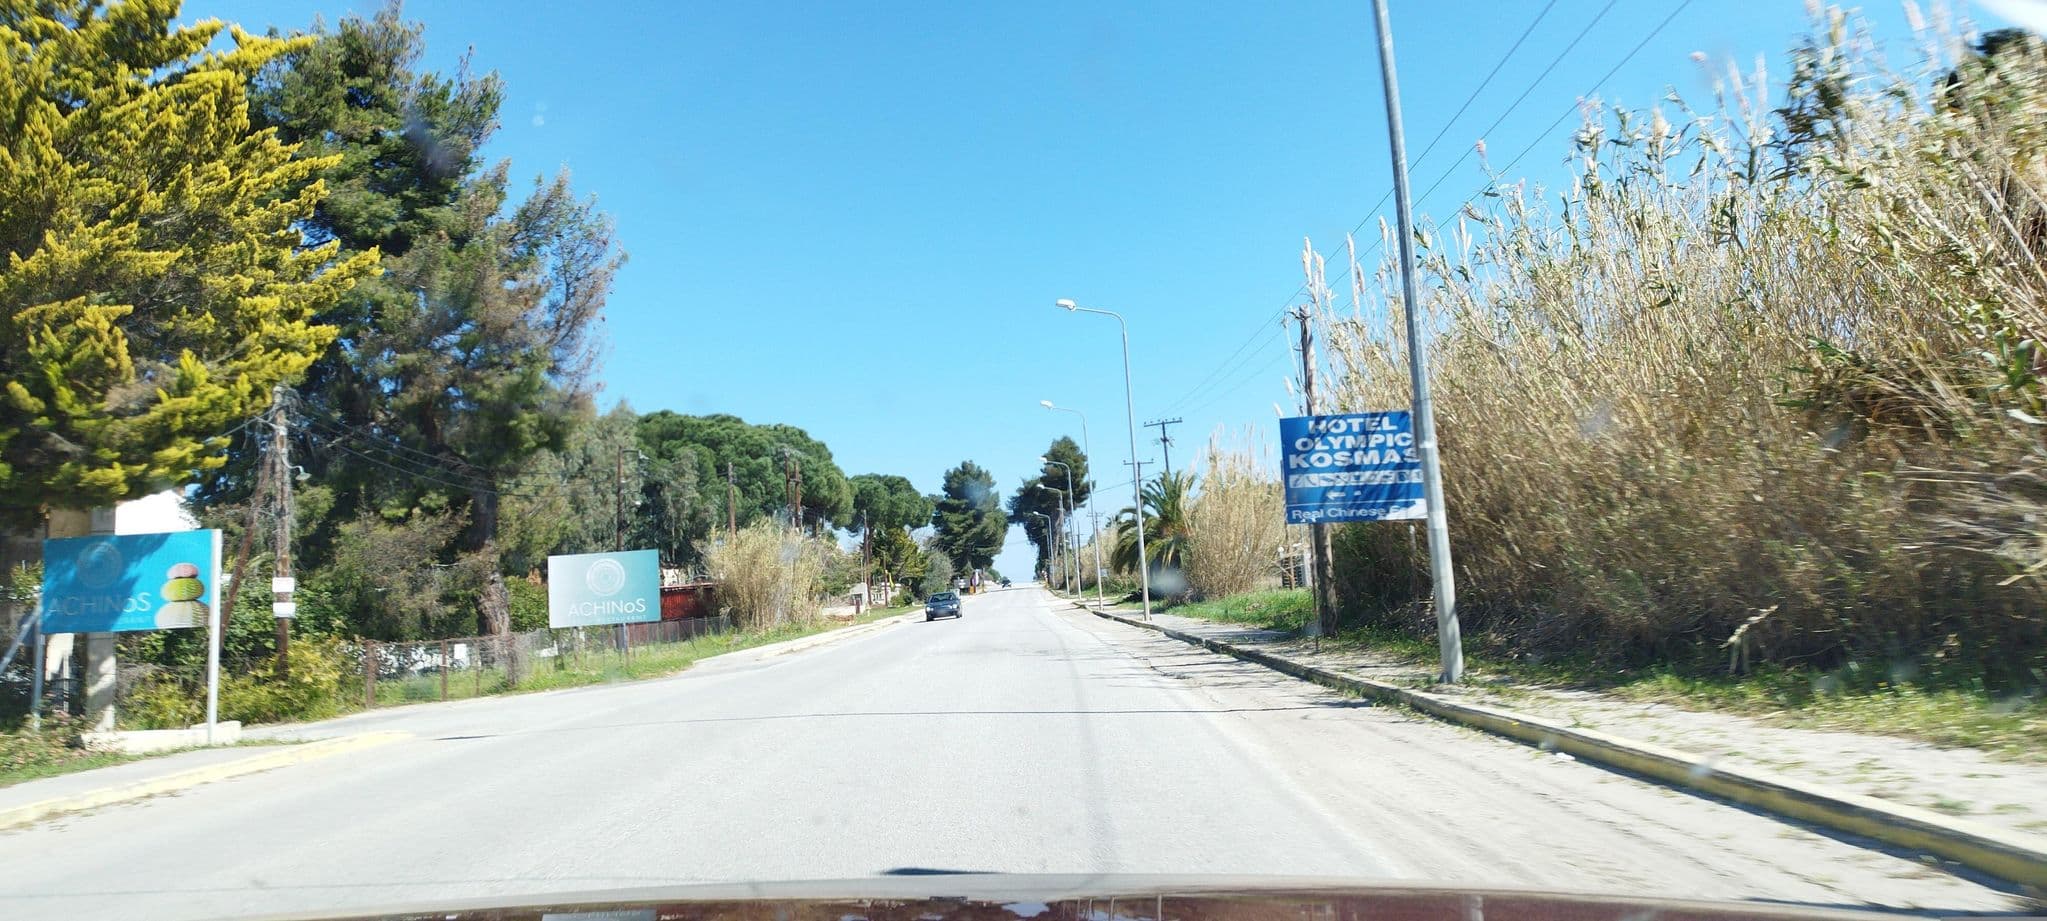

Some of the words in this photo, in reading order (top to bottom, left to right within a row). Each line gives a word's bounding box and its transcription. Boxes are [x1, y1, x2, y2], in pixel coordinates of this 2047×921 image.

[1308, 416, 1398, 434] HOTEL
[1295, 432, 1413, 451] OLYMPIC
[1289, 448, 1421, 469] KOSMAS
[1292, 508, 1324, 520] Real
[1327, 505, 1386, 517] Chinese
